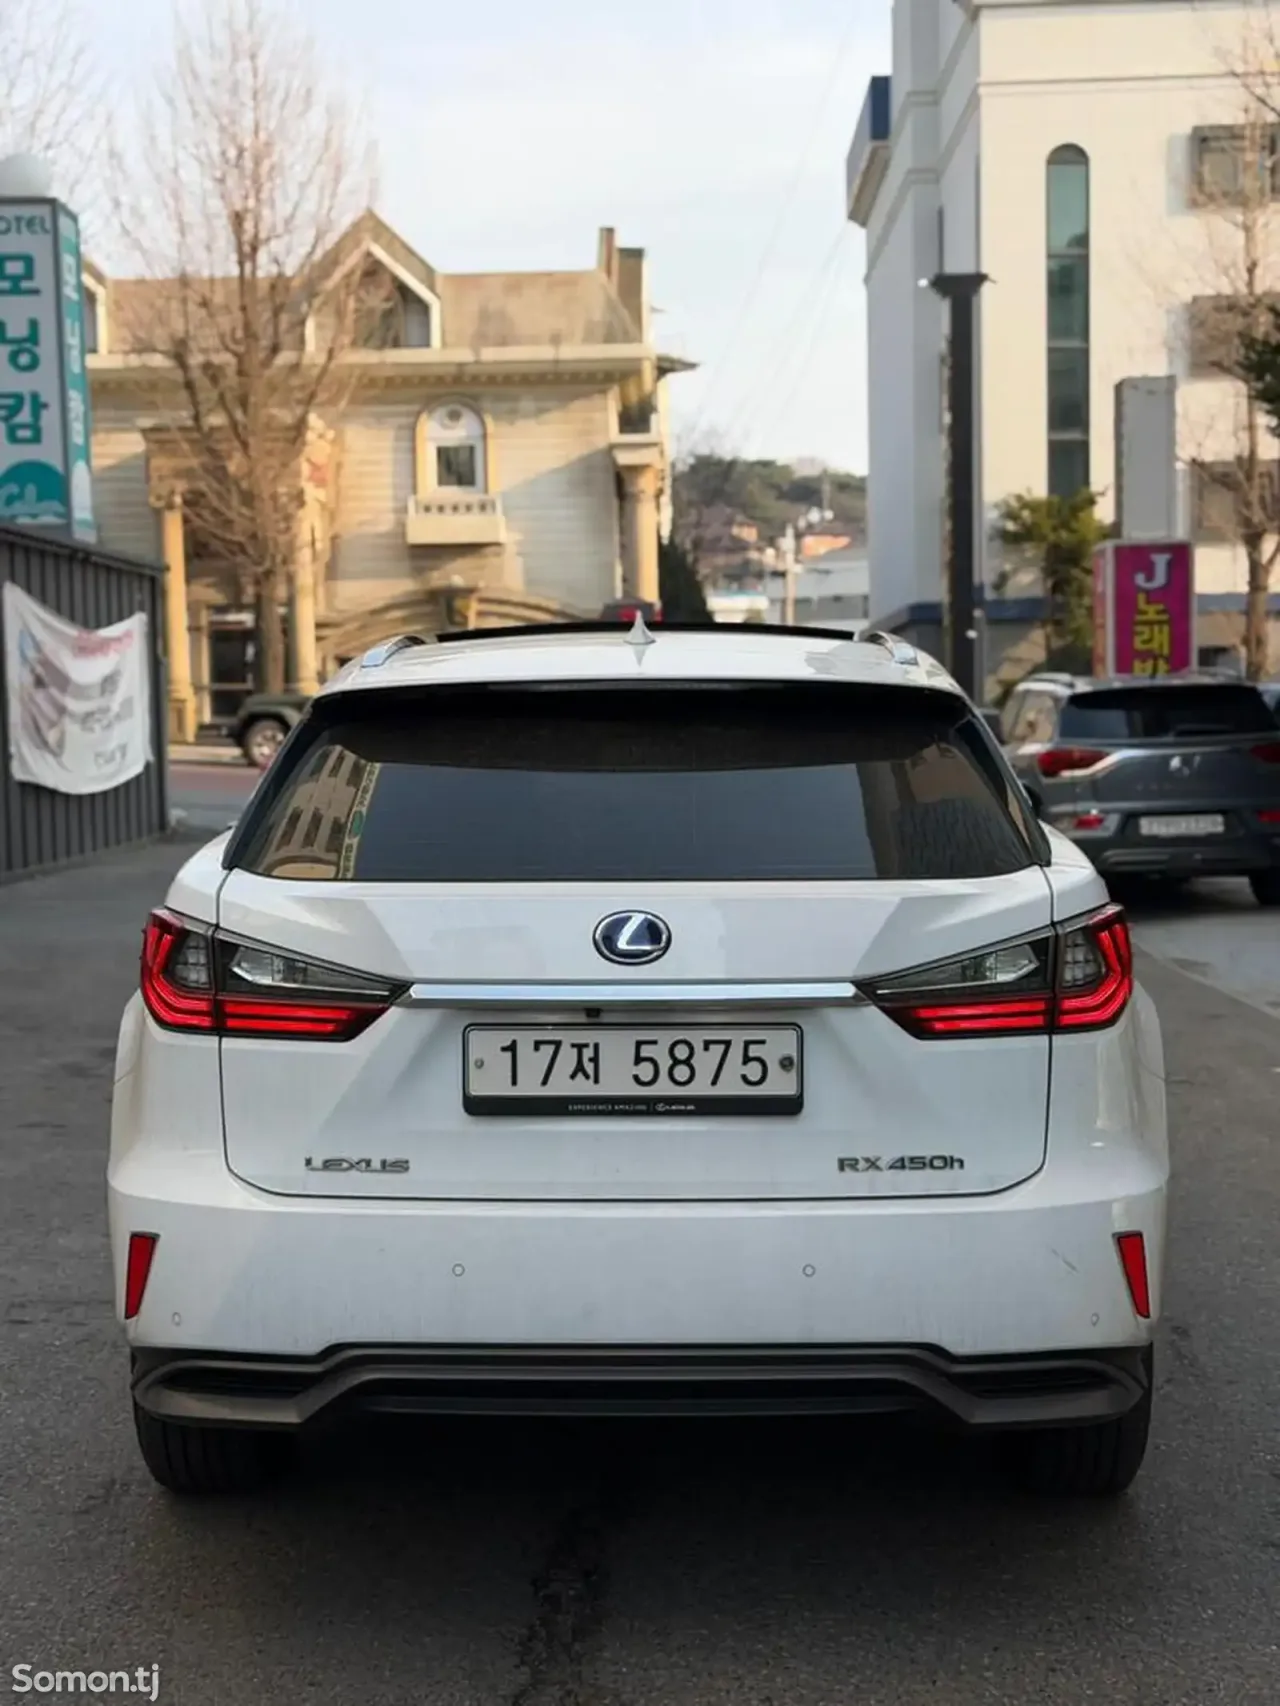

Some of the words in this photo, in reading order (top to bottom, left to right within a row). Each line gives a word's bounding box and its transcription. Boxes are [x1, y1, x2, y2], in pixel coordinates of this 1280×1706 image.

[0, 253, 49, 445] 모닝캄
[1134, 553, 1173, 590] J
[500, 1038, 600, 1087] 17저
[632, 1038, 769, 1087] 5875
[304, 1156, 410, 1173] LEXUS
[837, 1156, 883, 1172] RX
[886, 1154, 965, 1171] 450h
